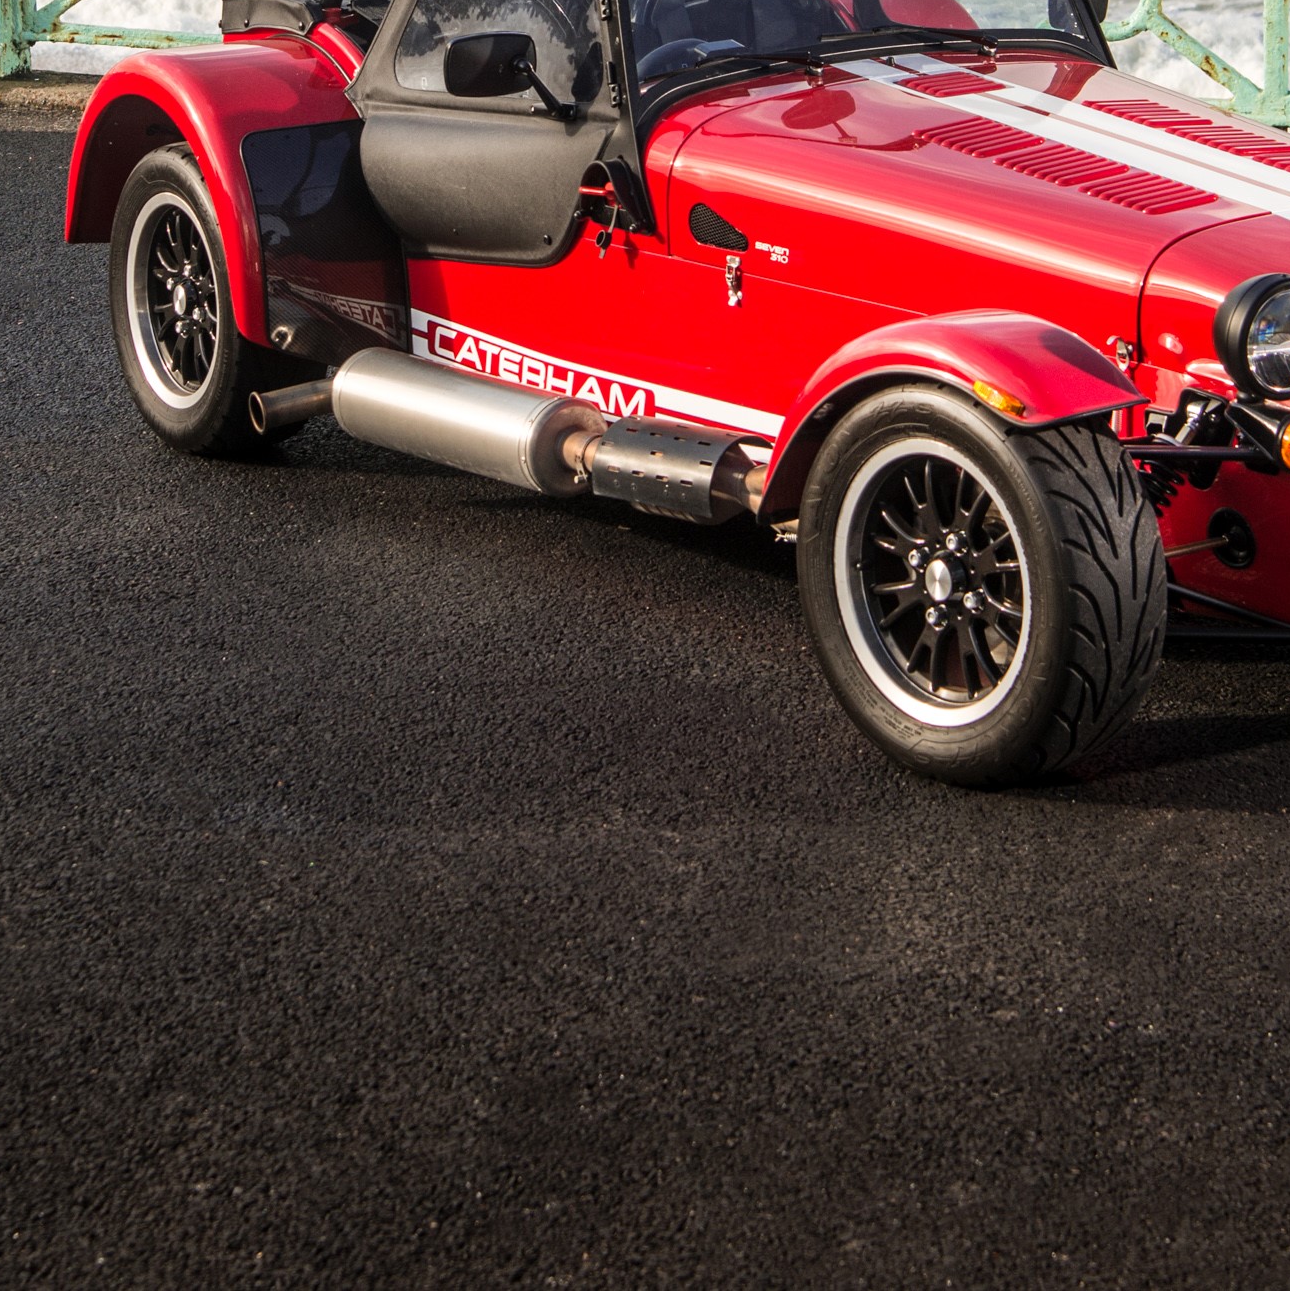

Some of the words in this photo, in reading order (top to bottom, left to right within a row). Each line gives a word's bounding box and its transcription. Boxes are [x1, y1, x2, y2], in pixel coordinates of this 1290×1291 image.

[755, 241, 789, 256] SEVEN
[770, 252, 789, 264] 310
[434, 326, 647, 417] CATERHAM
